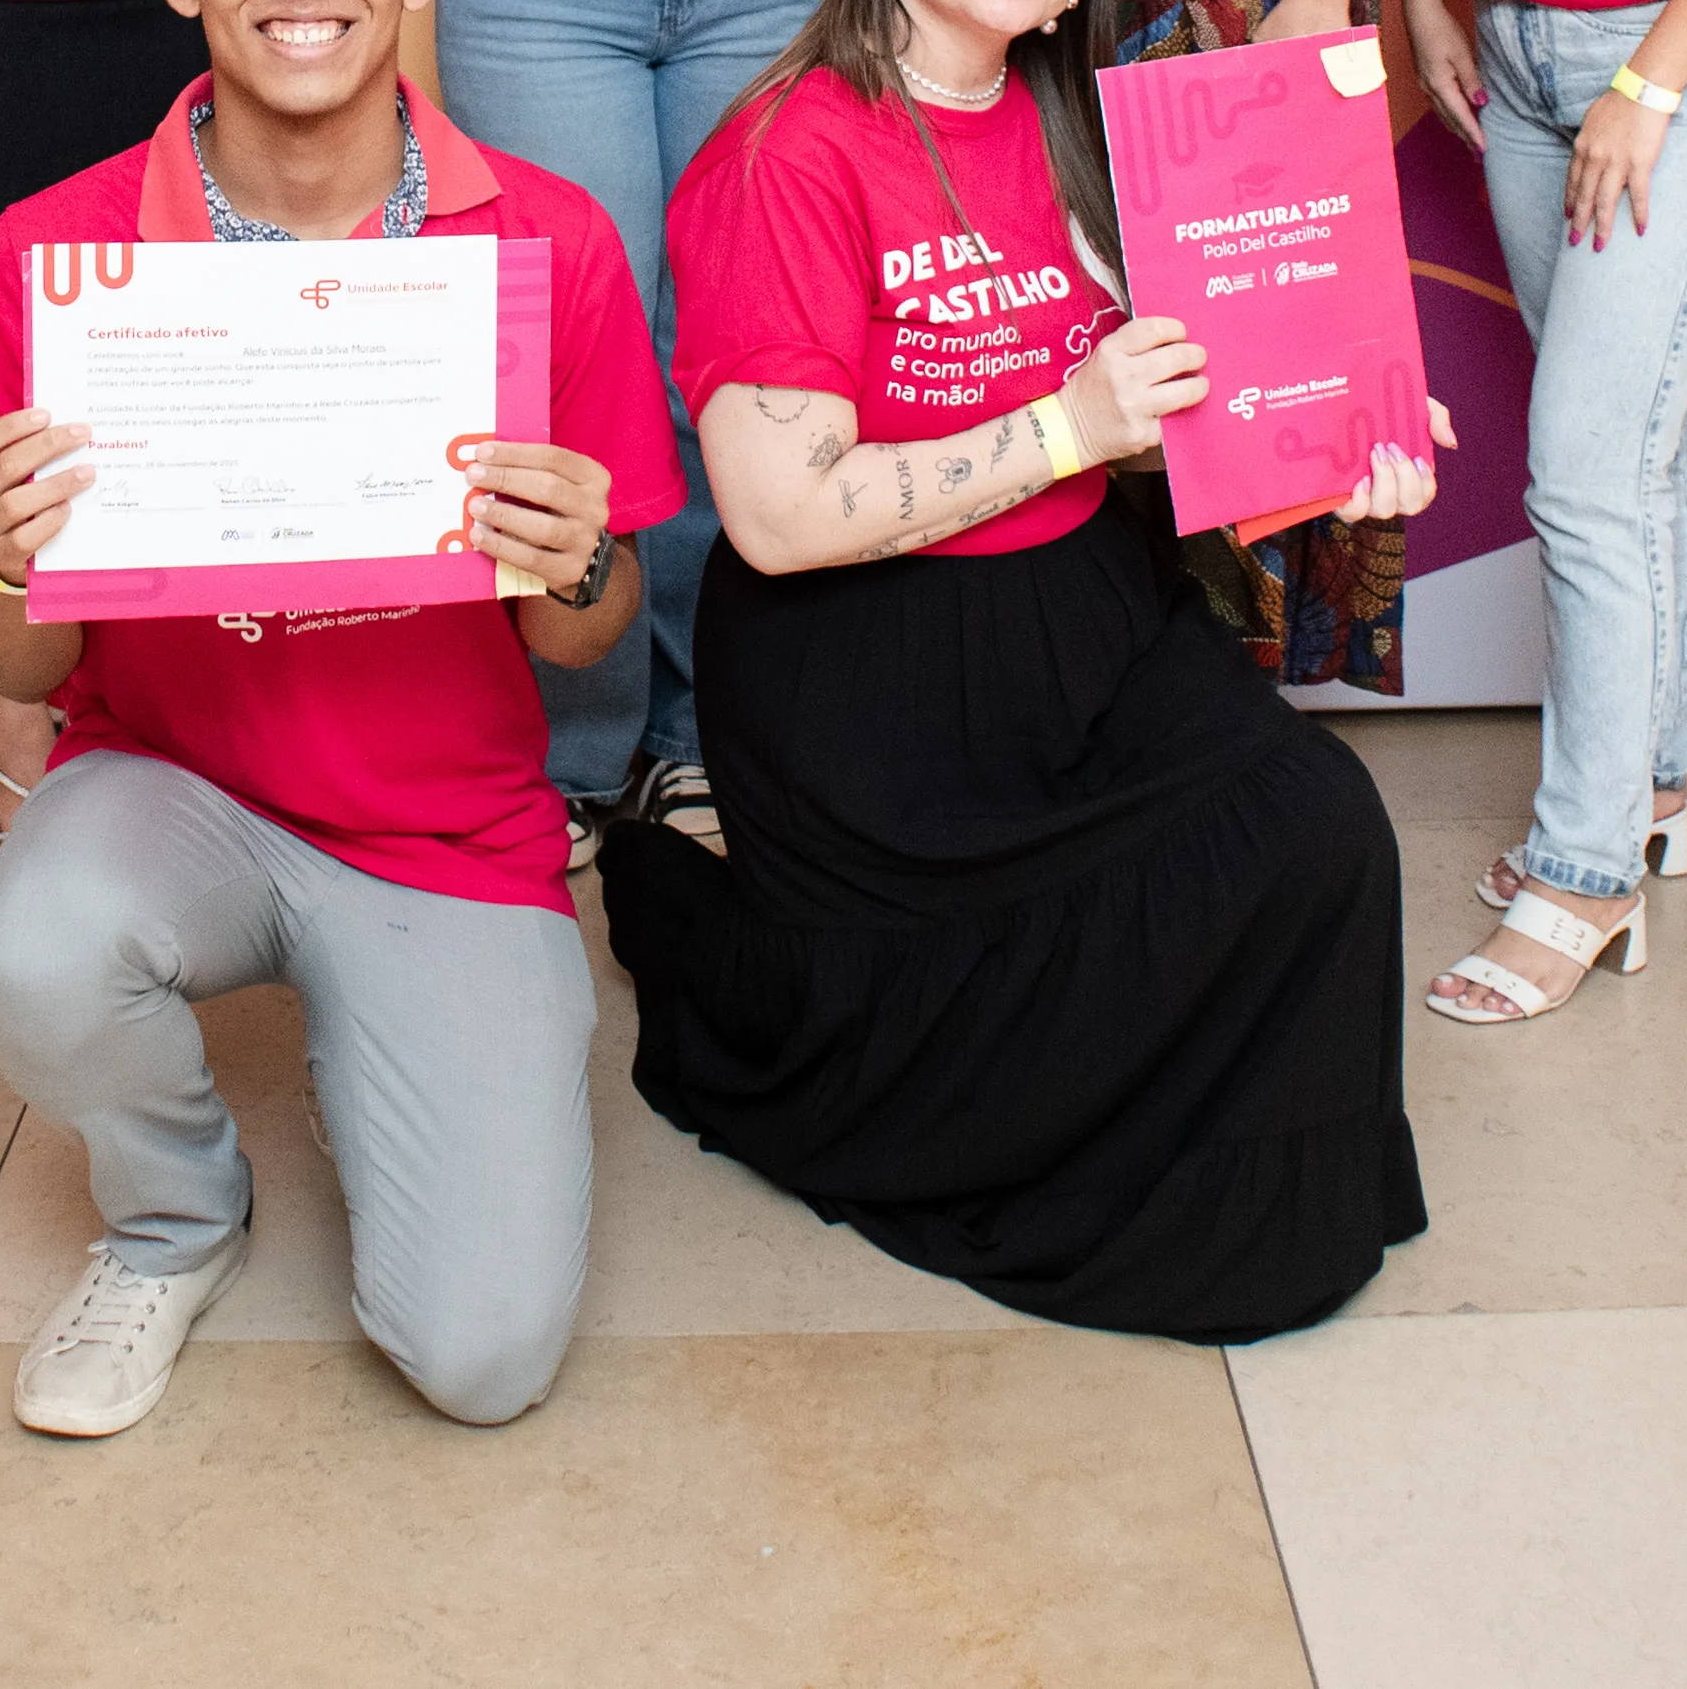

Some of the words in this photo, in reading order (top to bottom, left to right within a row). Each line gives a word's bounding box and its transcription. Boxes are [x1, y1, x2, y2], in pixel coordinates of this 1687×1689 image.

[1175, 204, 1304, 243] FORMATURA
[1305, 195, 1351, 220] 2025
[1203, 241, 1237, 260] Polo
[1240, 234, 1266, 253] Del
[1268, 225, 1331, 248] Castilho
[883, 240, 936, 290] DE
[940, 232, 1004, 271] DEL
[348, 283, 400, 294] Unidade
[403, 281, 449, 292] Escolar
[895, 265, 1071, 324] CASTILHO
[87, 327, 171, 340] Certificado
[175, 326, 229, 339] afetivo
[896, 327, 937, 349] pro
[941, 323, 1022, 353] mundo,
[311, 346, 323, 356] da
[326, 344, 348, 355] Silva
[890, 354, 905, 371] e
[911, 359, 963, 379] com
[969, 346, 1050, 378] diploma
[171, 364, 202, 374] grande
[235, 363, 254, 373] Que
[886, 380, 916, 402] na
[923, 383, 985, 406] mão!
[1264, 382, 1309, 401] Unidade
[1308, 375, 1349, 392] Escolar
[88, 439, 148, 450] Parabéns!
[895, 458, 915, 520] AMOR
[286, 616, 336, 636] Fundação
[337, 612, 379, 627] Roberto
